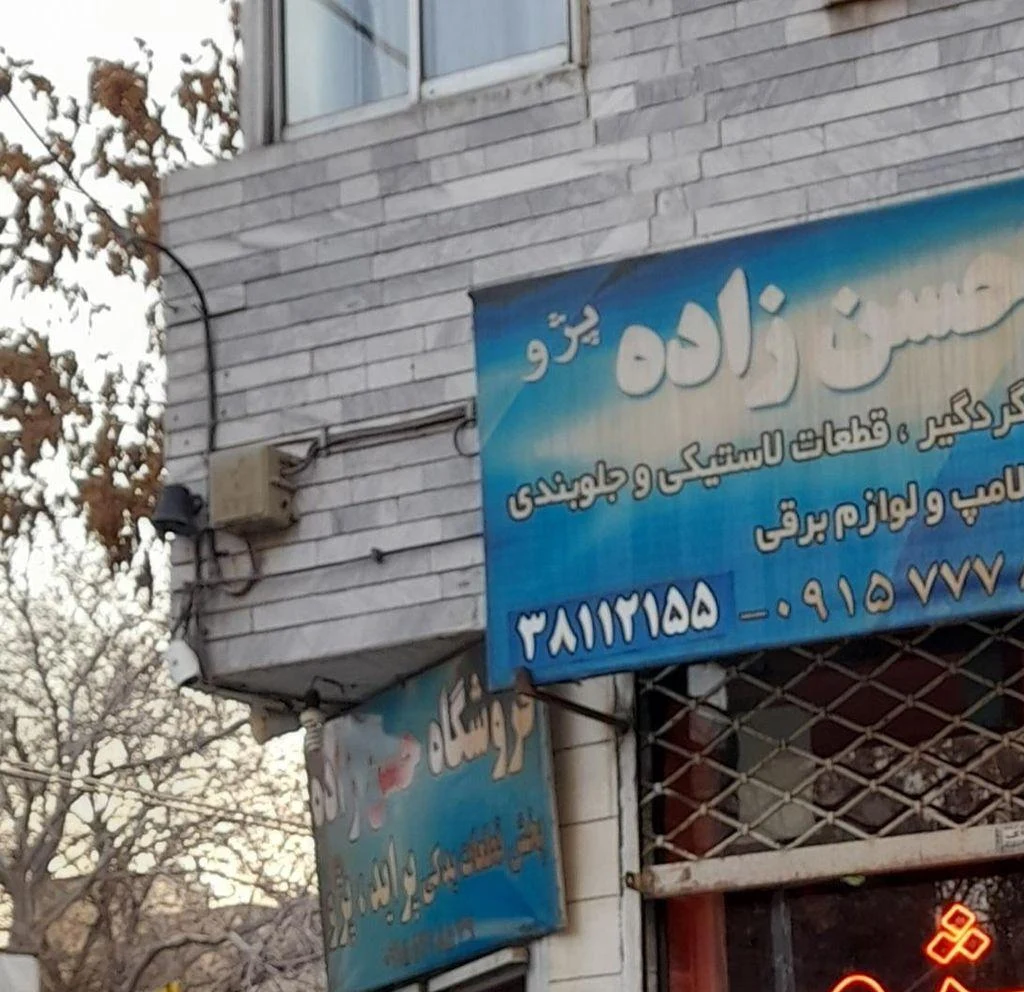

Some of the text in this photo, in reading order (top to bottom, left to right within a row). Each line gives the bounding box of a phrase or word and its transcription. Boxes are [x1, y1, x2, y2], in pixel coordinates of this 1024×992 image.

[615, 267, 800, 410] زاده
[656, 430, 784, 494] لاستیکی
[791, 409, 890, 462] قطعات
[507, 461, 628, 520] جلوبندی
[834, 482, 920, 540] لوازم
[924, 492, 945, 525] و
[753, 500, 829, 553] برقی
[516, 580, 719, 662] ۳۸۱۱۲۱۵۵
